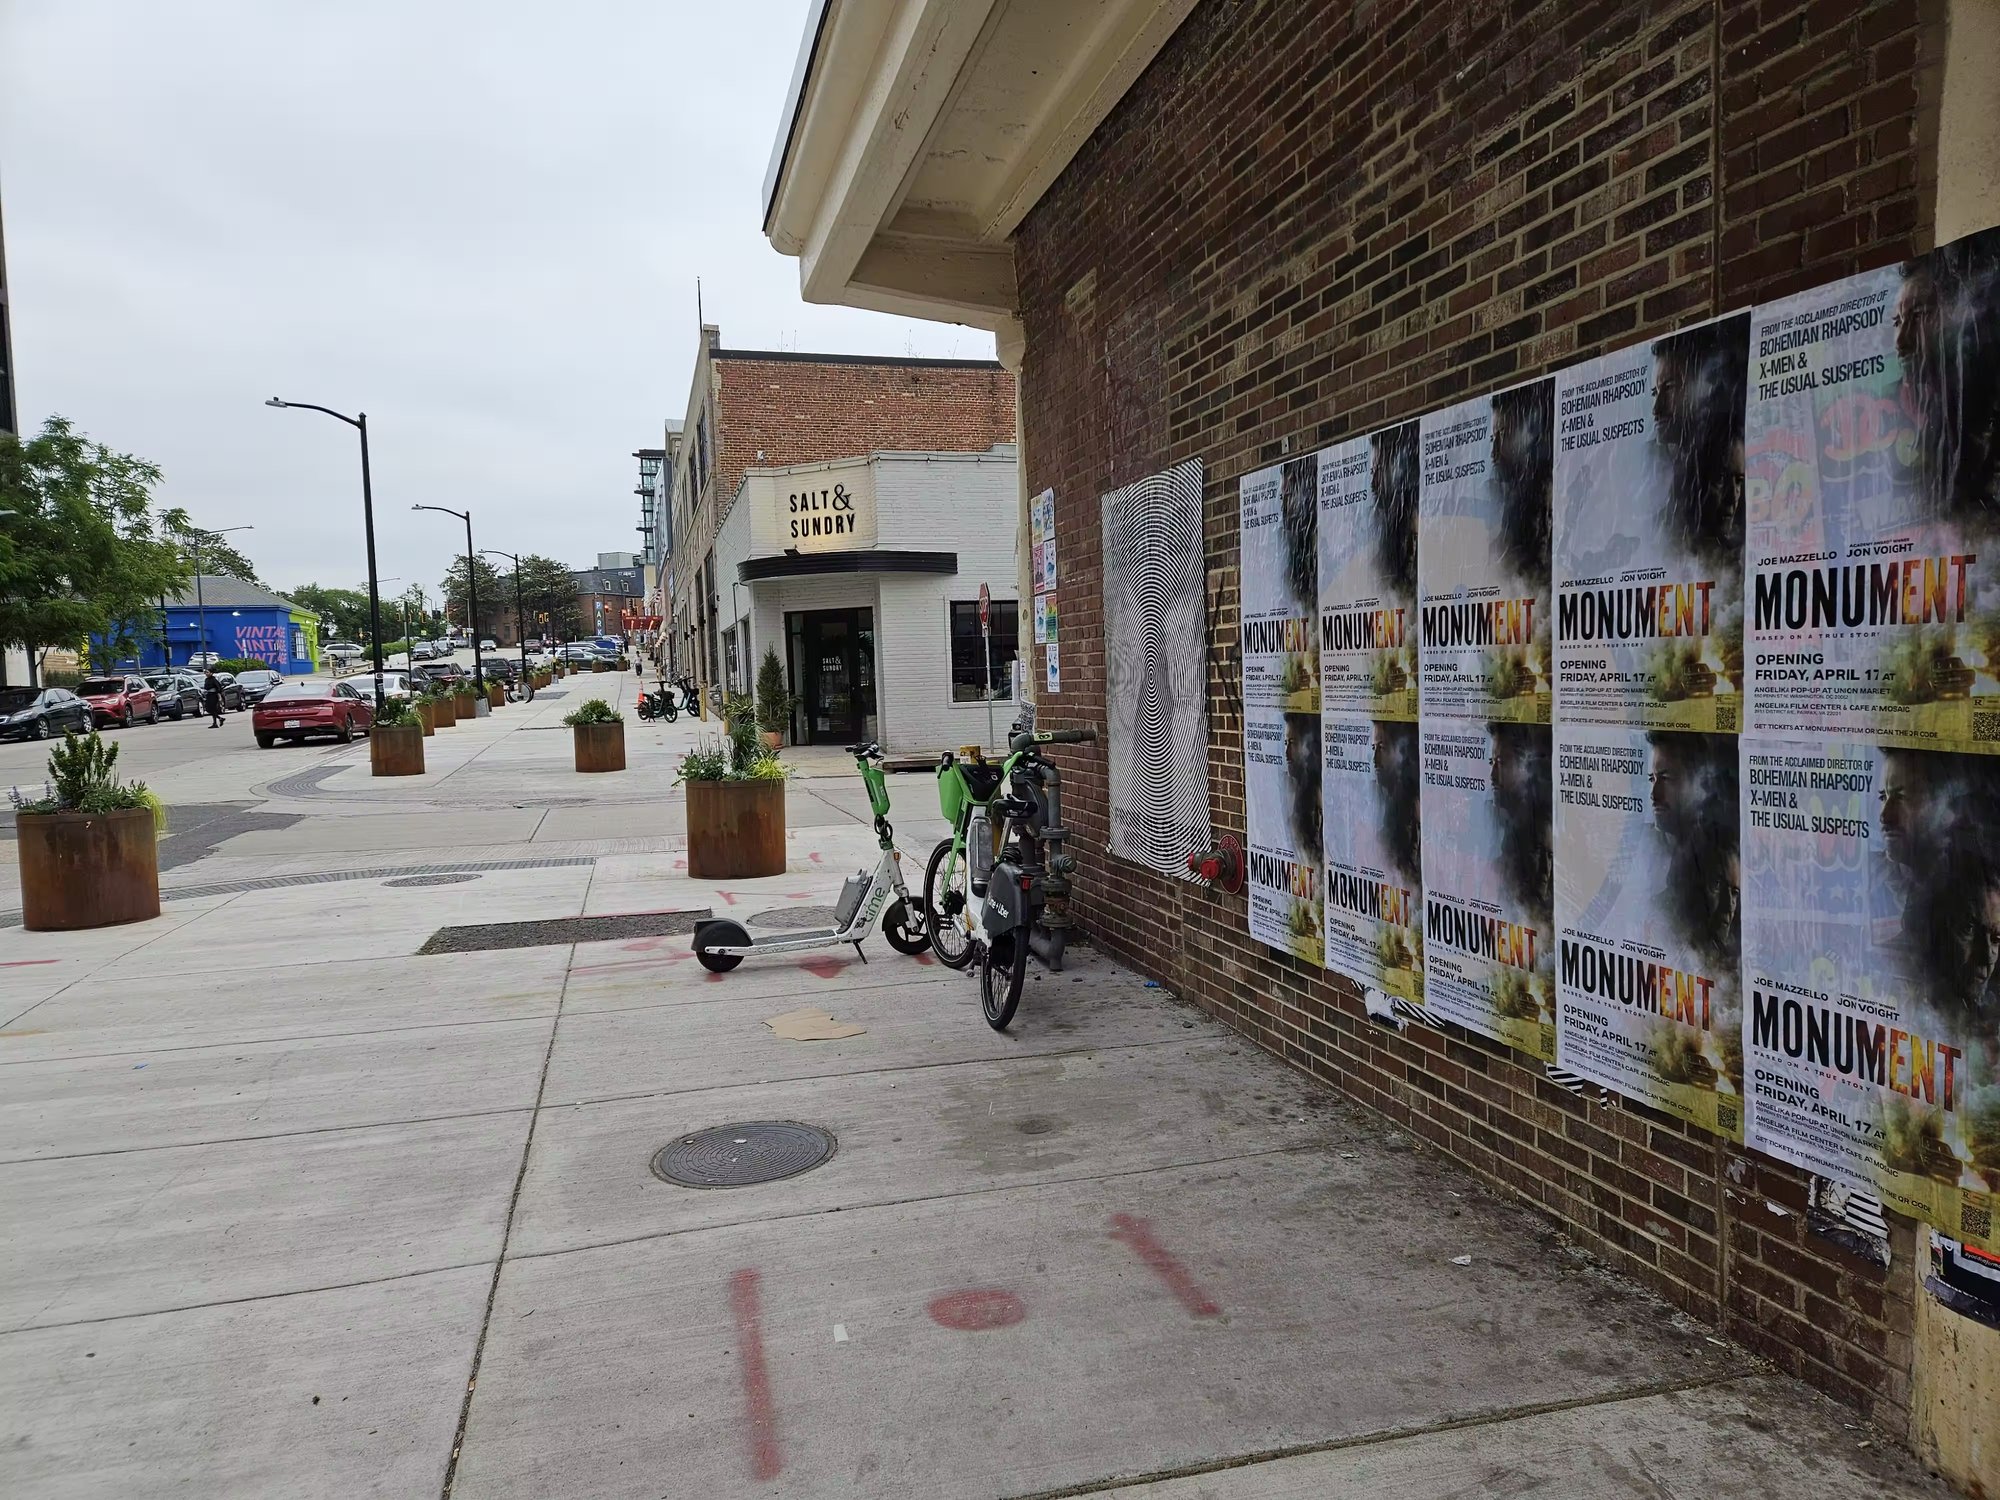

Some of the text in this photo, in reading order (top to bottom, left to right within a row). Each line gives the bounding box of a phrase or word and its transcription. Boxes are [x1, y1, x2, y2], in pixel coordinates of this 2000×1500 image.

[1761, 289, 1889, 337] FROM THE ACCLAIMED DIRECTOR OF
[1760, 305, 1885, 358] BOHEMIAN RHAPSODY
[1759, 354, 1885, 401] THE USUAL SUSPECTS
[1760, 351, 1808, 380] X-MEN &
[1561, 378, 1647, 417] BOHEMIAN RHAPSODY
[1561, 413, 1594, 435] X-MEN &
[1561, 418, 1645, 452] THE USUAL SUSPECTS
[790, 484, 855, 513] SALT &
[791, 513, 855, 539] SUNDRY
[1757, 542, 1914, 566] JOE MAZZELLO JON VOIGHT
[1559, 580, 1574, 588] JOE
[1575, 576, 1614, 586] MAZZELLO
[1620, 574, 1635, 583] JON
[1638, 571, 1667, 581] VOIGHT
[1755, 554, 1977, 631] MONUMENT
[595, 601, 603, 636] PARK
[1422, 598, 1536, 648] MONUMENT
[1559, 581, 1716, 641] MONUMENT
[1244, 617, 1309, 654] MONUMENT
[1322, 608, 1405, 651] MONUMENT
[1324, 664, 1350, 673] OPENING
[1424, 663, 1458, 672] OPENING
[1560, 660, 1607, 670] OPENING
[1755, 653, 1824, 666] OPENING
[1475, 675, 1486, 683] 17
[1560, 672, 1597, 683] FRIDAY,
[1600, 672, 1631, 682] APRIL
[1633, 673, 1645, 682] 17
[1755, 669, 1896, 682] FRIDAY, APRIL 17 AT
[1879, 705, 1910, 713] MOSAIC
[1560, 755, 1644, 775] BOHEMIAN RHAPSODY
[1749, 755, 1874, 771] FROM THE ACCLAIMED DIRECTOR OF
[1560, 772, 1593, 789] X-MEN &
[1750, 769, 1873, 793] BOHEMIAN RHAPSODY
[1560, 789, 1643, 813] THE USUAL SUSPECTS
[1750, 789, 1798, 809] X-MEN &
[1750, 810, 1870, 839] THE USUAL SUSPECTS
[1250, 851, 1314, 901] MONUMENT
[1327, 869, 1411, 928] MONUMENT
[1329, 917, 1355, 933] OPENING
[1427, 900, 1537, 974] MONUMENT
[1562, 927, 1667, 961] JOE MAZZELLO JON VOIGHT
[1429, 955, 1463, 973] OPENING
[1429, 965, 1490, 997] FRIDAY, APRIL 17
[1561, 940, 1715, 1031] MONUMENT
[1753, 977, 1900, 1021] JOE MAZZELLO JON VOIGHT
[1563, 1004, 1609, 1027] OPENING
[1564, 1016, 1600, 1037] FRIDAY,
[1601, 1030, 1633, 1048] APRIL
[1635, 1041, 1647, 1053] 17
[1752, 991, 1962, 1113] MONUMENT
[1753, 1050, 1783, 1063] BASED
[1815, 1069, 1837, 1081] TRUE
[1841, 1078, 1871, 1092] STORY
[1754, 1069, 1820, 1099] OPENING
[1755, 1083, 1887, 1140] FRIDAY, APRIL 17 AT
[1755, 1100, 1883, 1152] ANGELIKA POP-UP AT UNION MARKET
[1755, 1115, 1790, 1131] ANGELIKA
[1791, 1127, 1809, 1138] FILM
[1810, 1134, 1839, 1150] CENTER
[1845, 1147, 1863, 1161] CAFE
[1873, 1161, 1899, 1178] MOSAIC
[1755, 1135, 1767, 1143] GET
[1769, 1140, 1795, 1155] TICKETS
[1795, 1150, 1804, 1158] AT
[1898, 1195, 1910, 1204] QR
[1911, 1200, 1933, 1215] CODE
